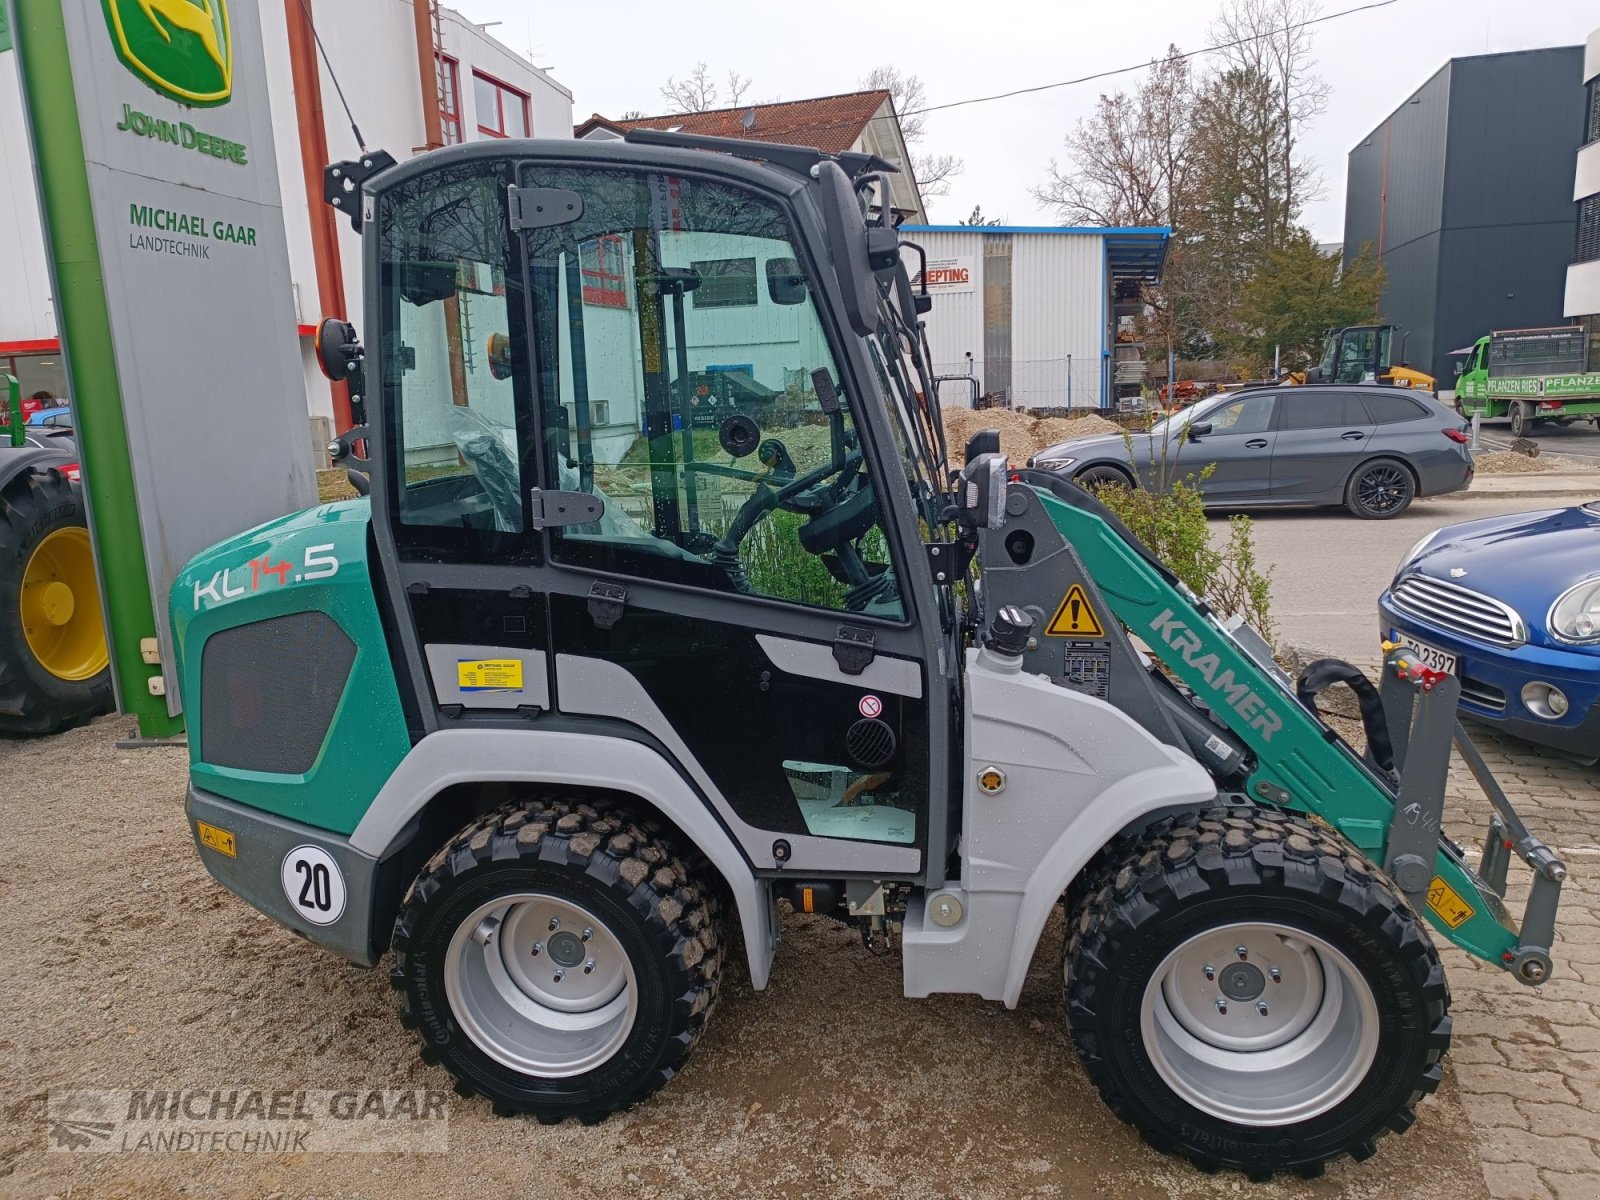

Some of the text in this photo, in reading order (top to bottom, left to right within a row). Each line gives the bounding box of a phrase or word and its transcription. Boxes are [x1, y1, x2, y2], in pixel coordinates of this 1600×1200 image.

[117, 104, 248, 166] JOHN DEERE
[129, 203, 257, 247] MICHAEL GAAR
[129, 233, 210, 259] LANDTECHNIK
[923, 268, 969, 283] EPTING
[1487, 380, 1520, 393] PFLANZEN
[1521, 379, 1537, 393] RIES
[1149, 608, 1283, 743] KRAMER
[1423, 647, 1455, 673] 2397
[295, 859, 332, 912] 20
